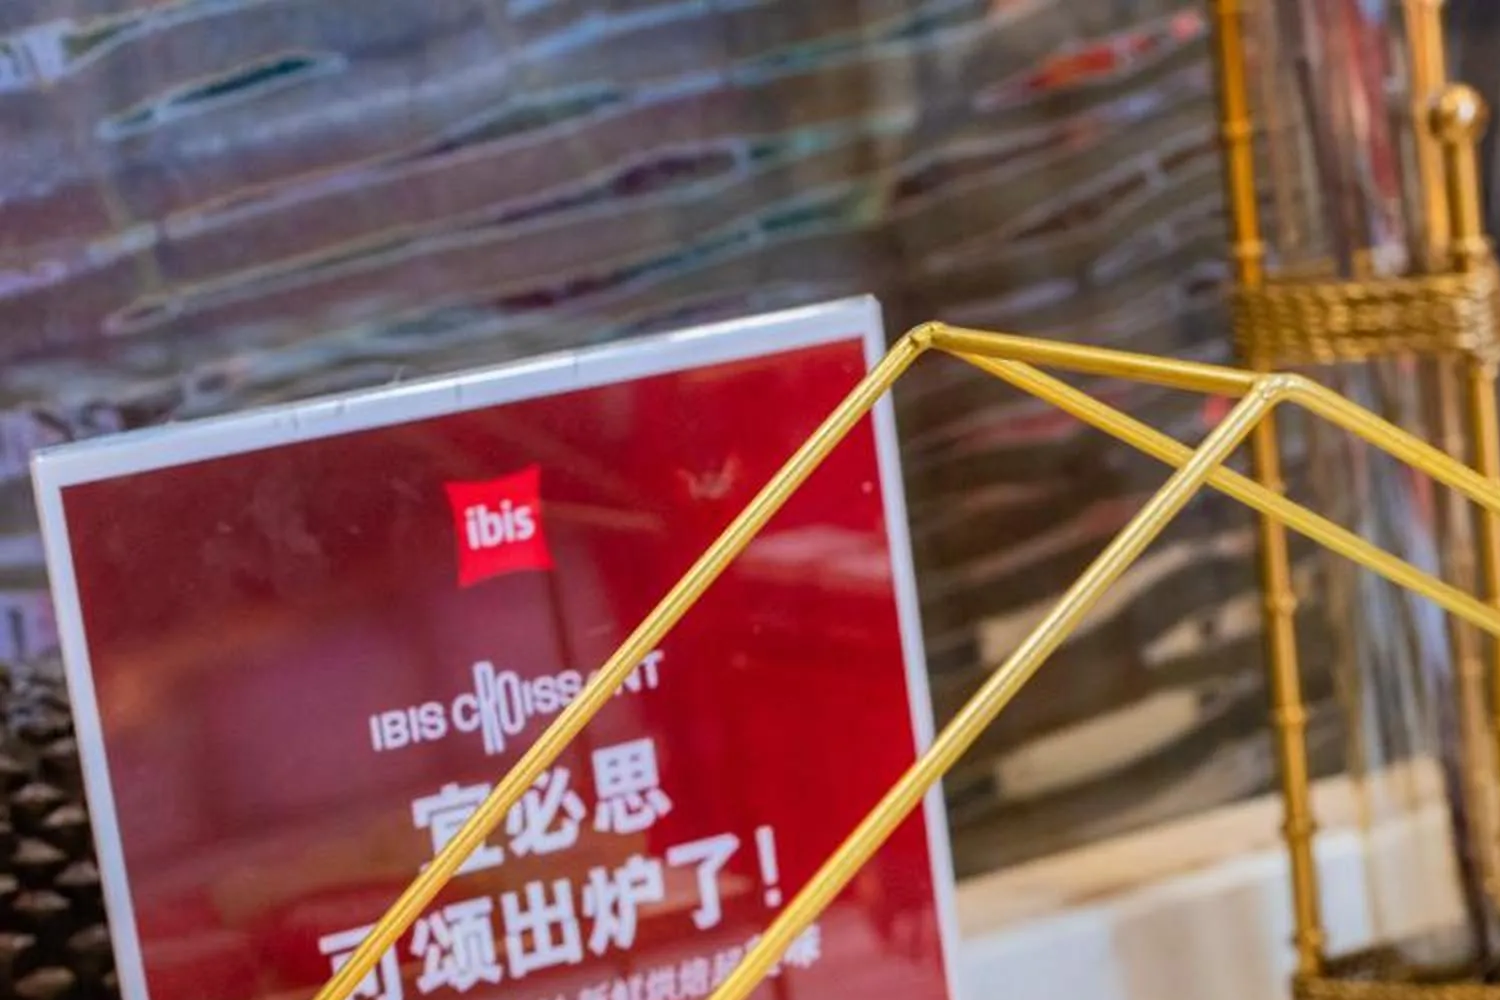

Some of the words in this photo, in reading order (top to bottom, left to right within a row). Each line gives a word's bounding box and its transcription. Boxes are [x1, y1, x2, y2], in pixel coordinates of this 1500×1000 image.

[464, 498, 536, 550] ibis
[368, 701, 448, 751] IBIS
[411, 738, 673, 879] 宜必思
